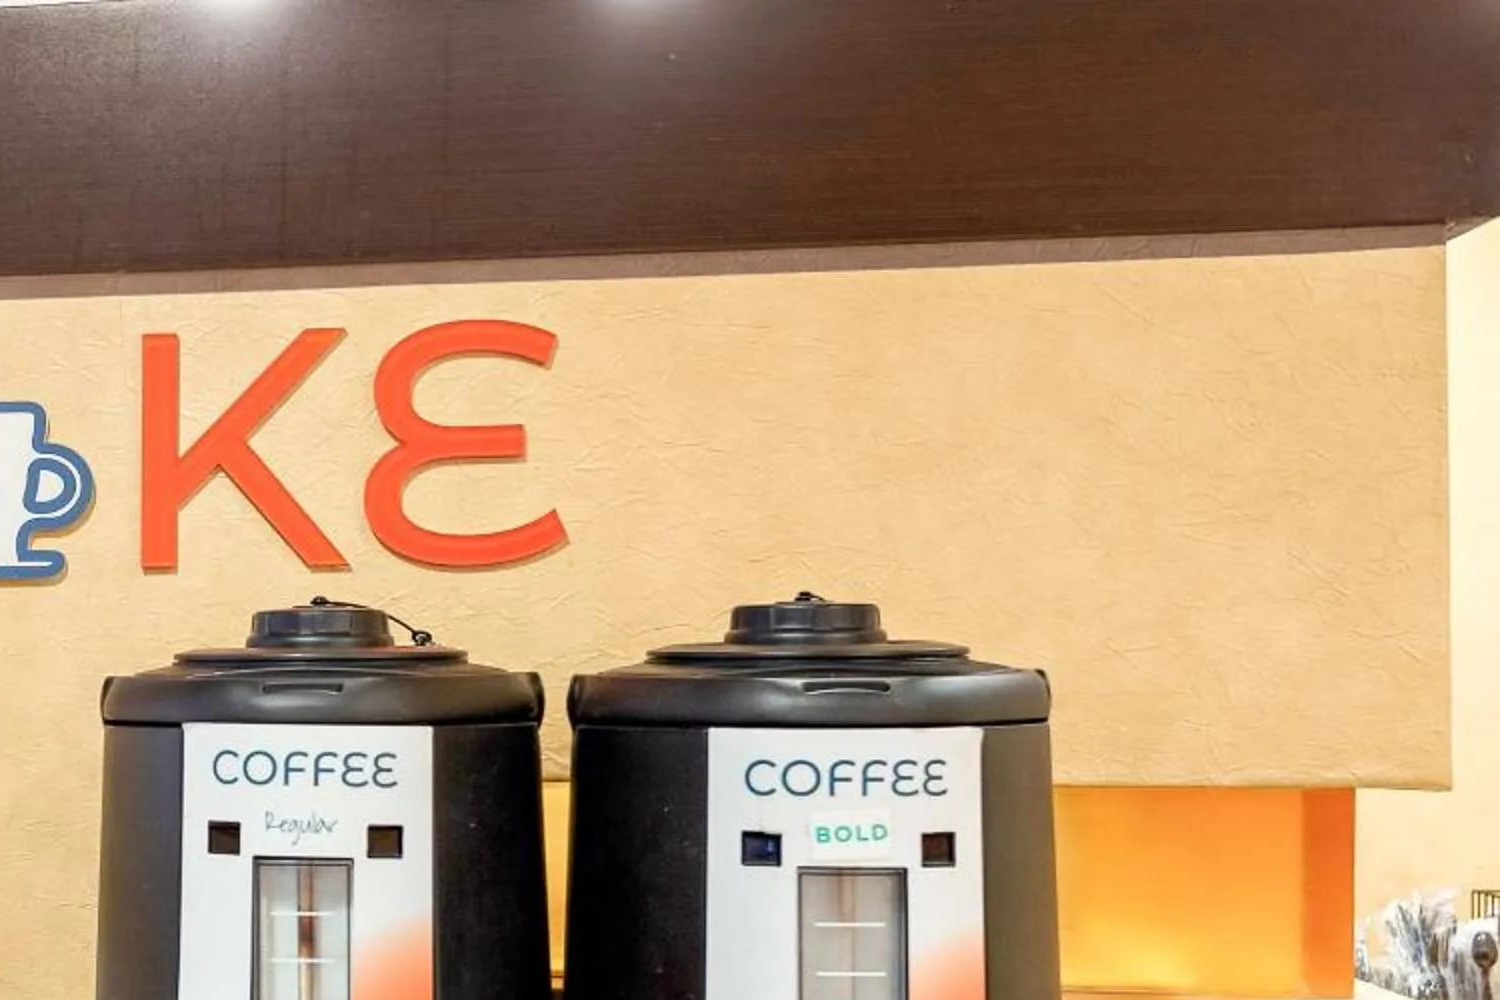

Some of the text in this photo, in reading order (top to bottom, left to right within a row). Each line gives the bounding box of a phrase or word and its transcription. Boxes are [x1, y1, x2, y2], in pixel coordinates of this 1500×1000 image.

[212, 749, 398, 789] COFFEE
[744, 759, 948, 797] COFFEE
[264, 809, 339, 847] Regular
[815, 823, 889, 844] BOLD
